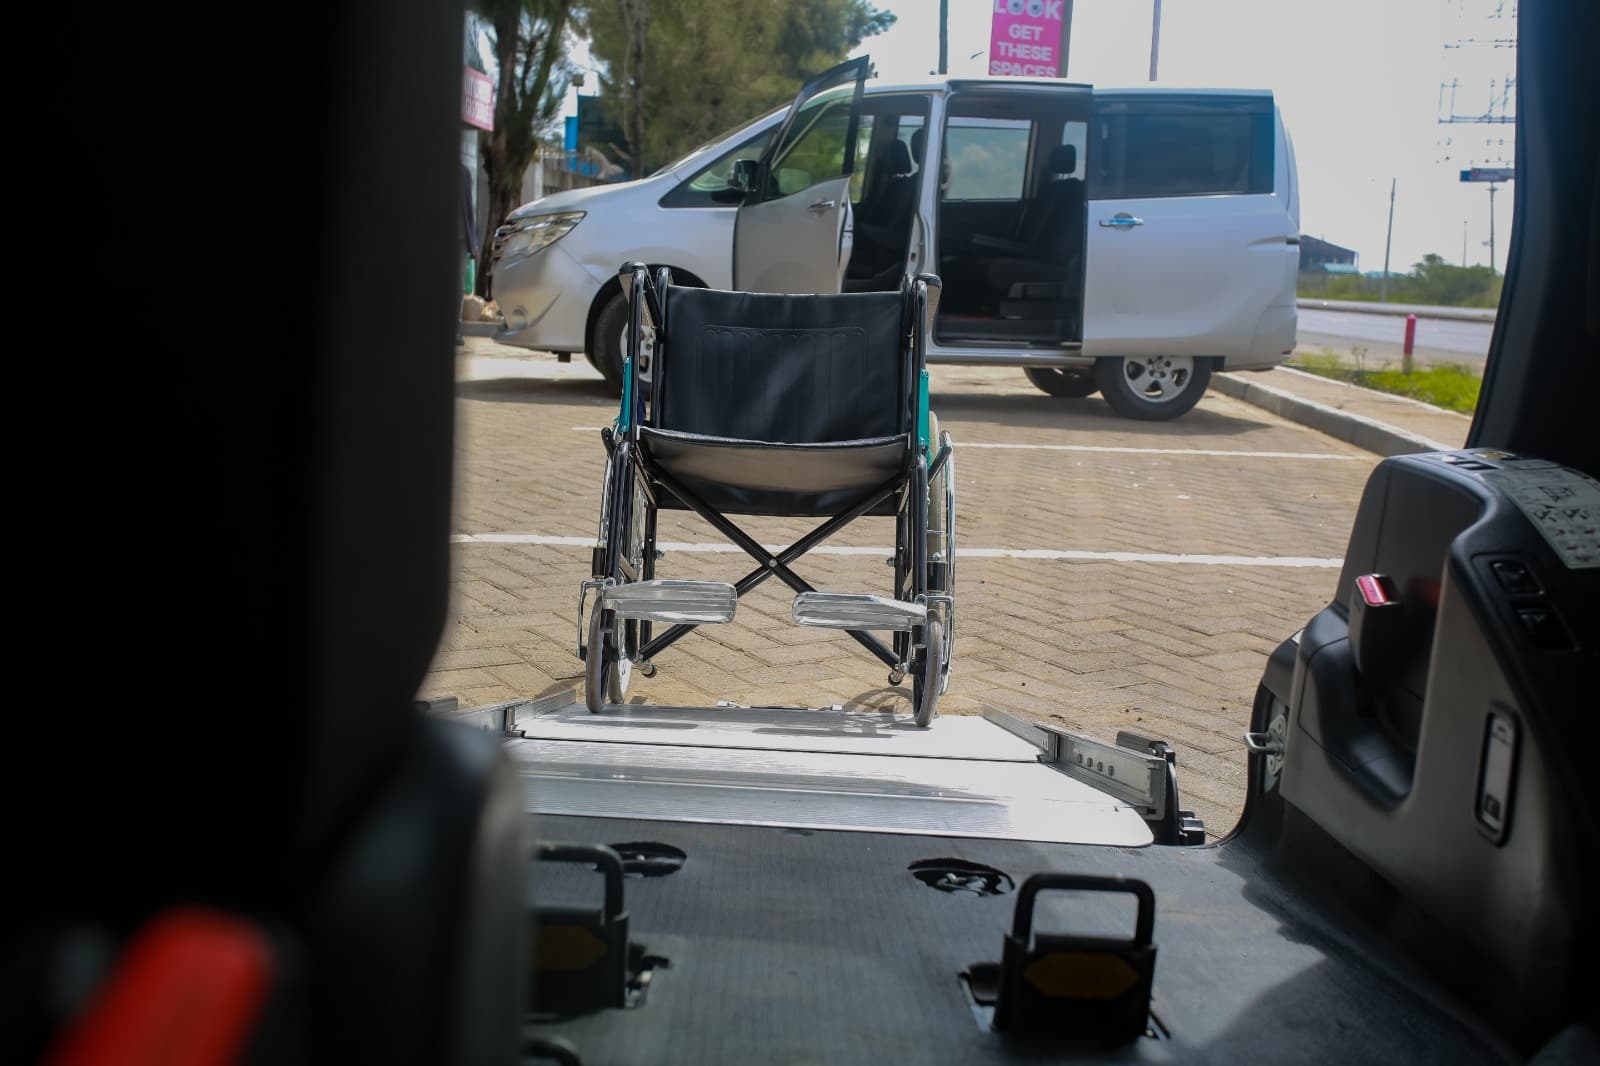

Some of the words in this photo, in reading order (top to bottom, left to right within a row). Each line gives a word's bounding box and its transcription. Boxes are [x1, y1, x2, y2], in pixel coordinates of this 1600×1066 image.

[993, 0, 1061, 20] LOOK
[1008, 24, 1044, 40] GET
[997, 41, 1052, 61] THESE
[990, 60, 1056, 77] SPACES
